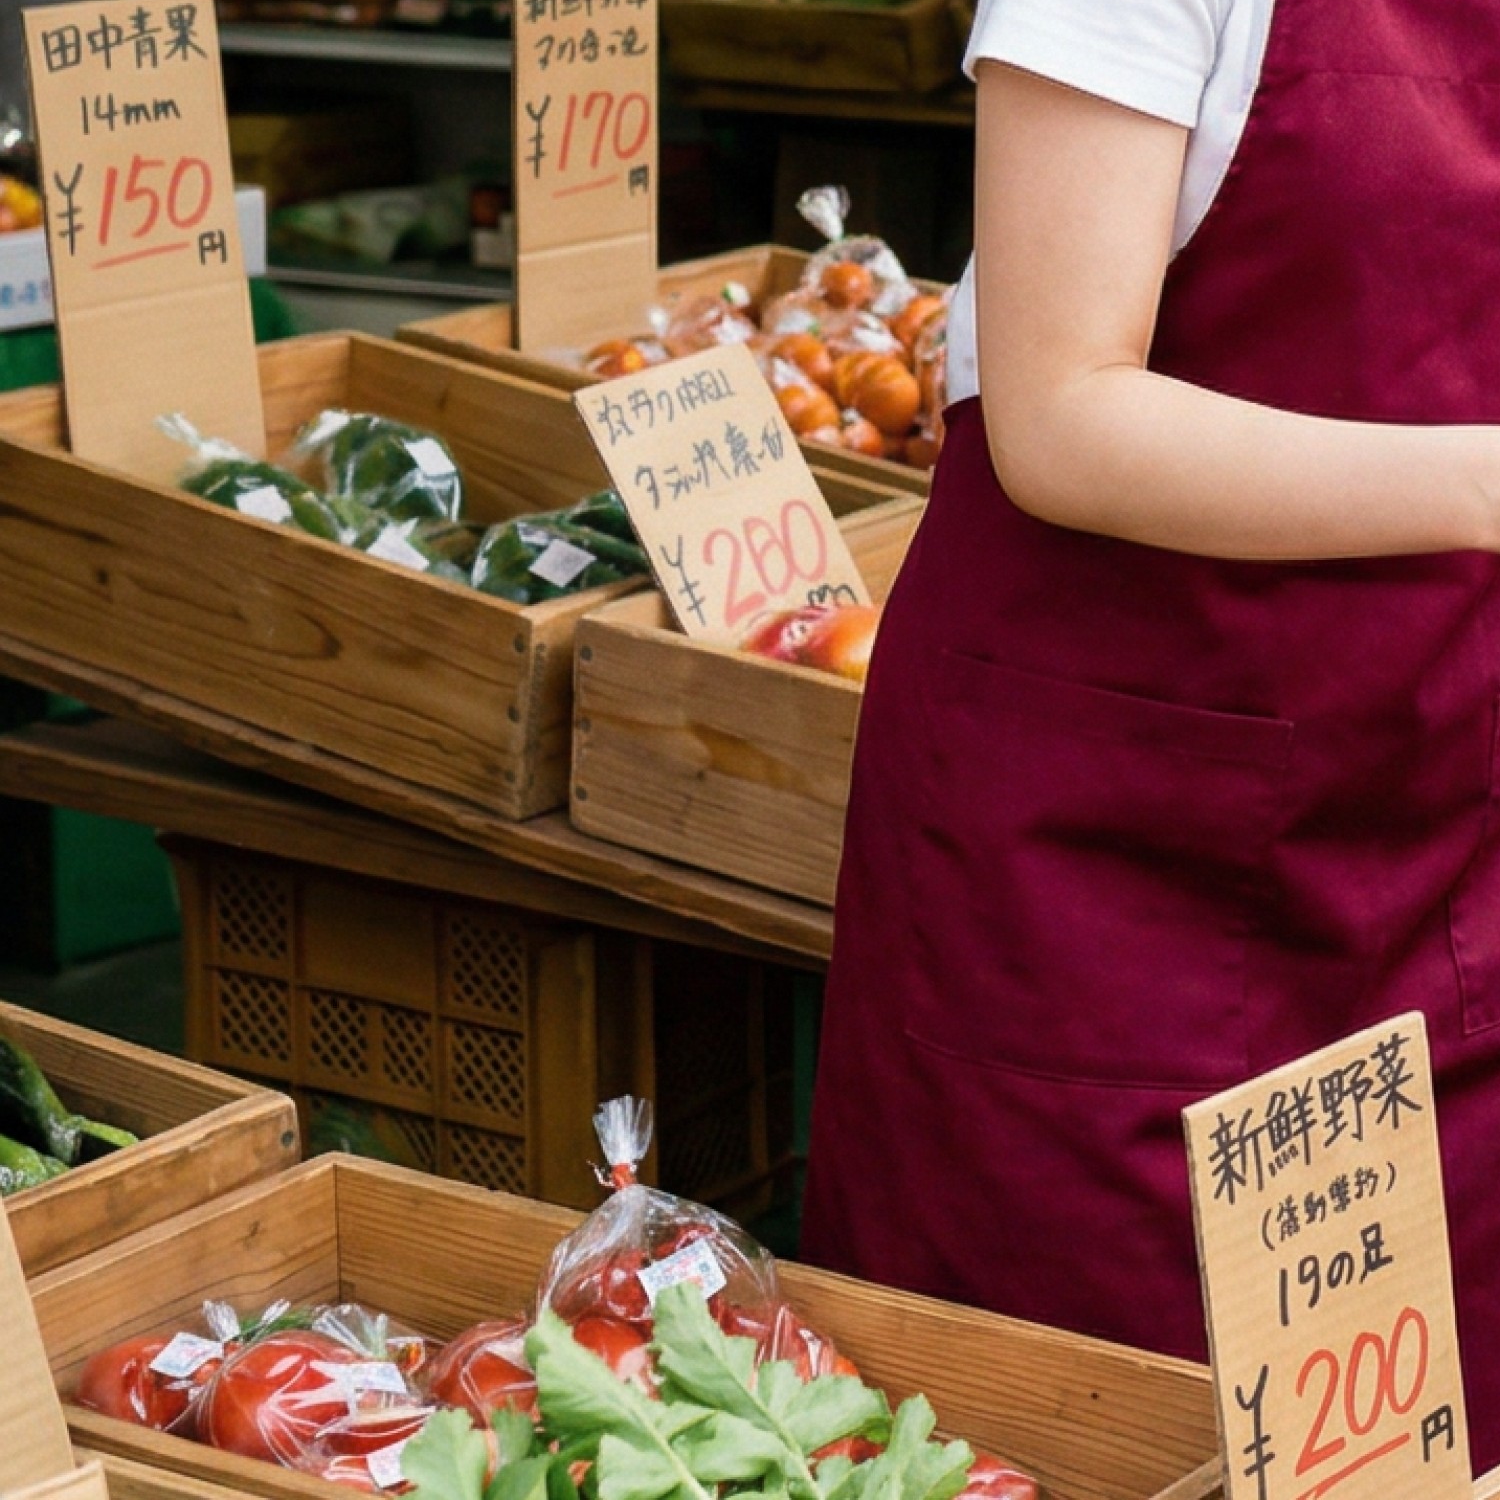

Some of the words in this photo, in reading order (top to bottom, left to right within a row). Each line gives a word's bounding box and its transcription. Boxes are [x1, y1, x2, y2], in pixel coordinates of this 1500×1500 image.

[41, 4, 207, 73] 田中青果
[80, 93, 182, 135] 14mm
[1208, 1033, 1424, 1206] 新鮮野菜
